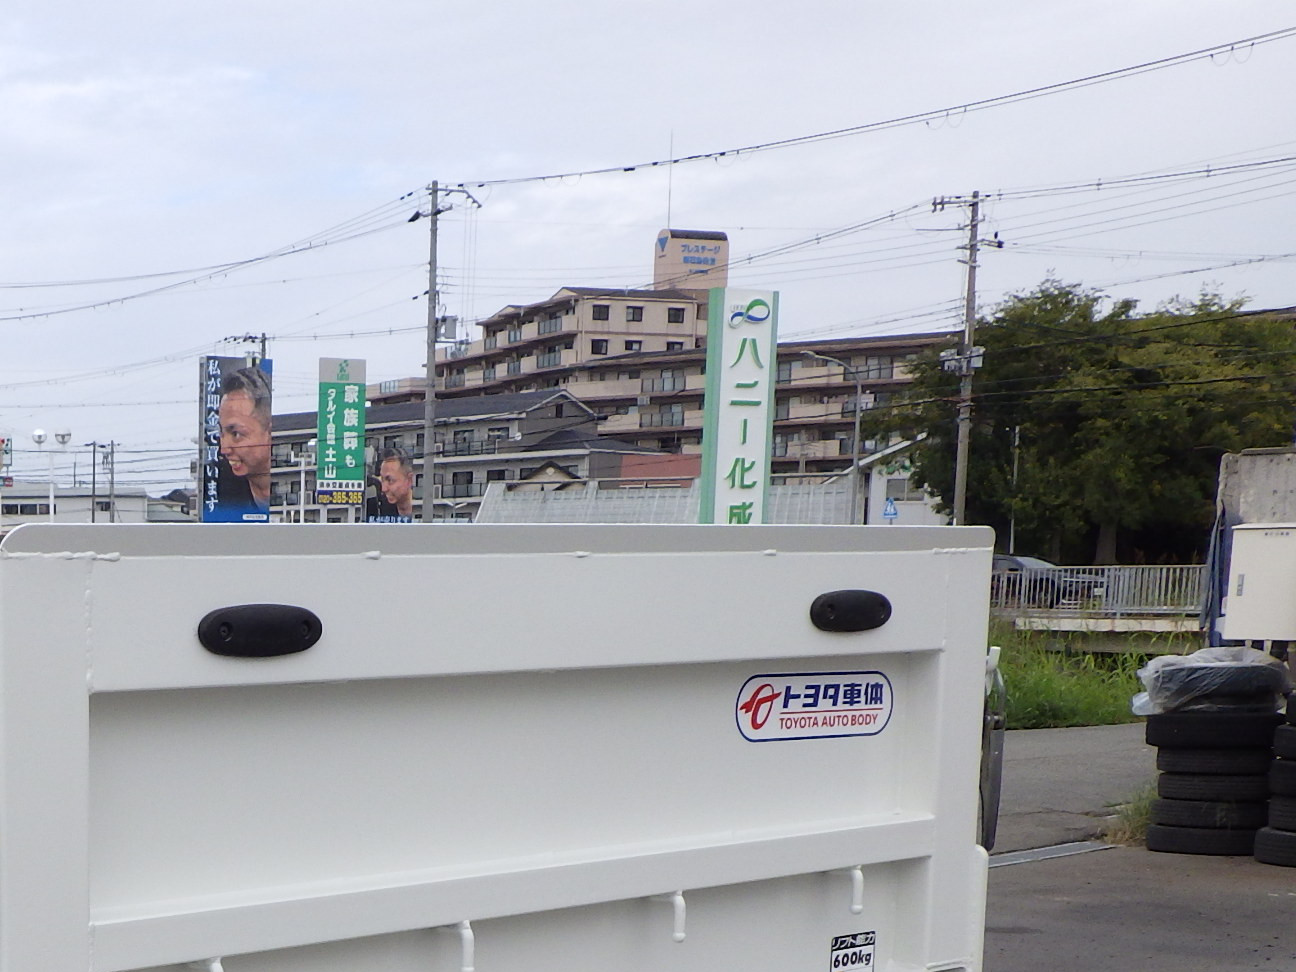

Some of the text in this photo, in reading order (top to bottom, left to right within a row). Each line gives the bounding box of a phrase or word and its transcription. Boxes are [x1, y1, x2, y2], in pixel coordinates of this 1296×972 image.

[782, 682, 884, 709] トヨタ車体
[779, 713, 879, 730] TOYOTA AUTO BODY
[833, 950, 872, 969] 600kg
